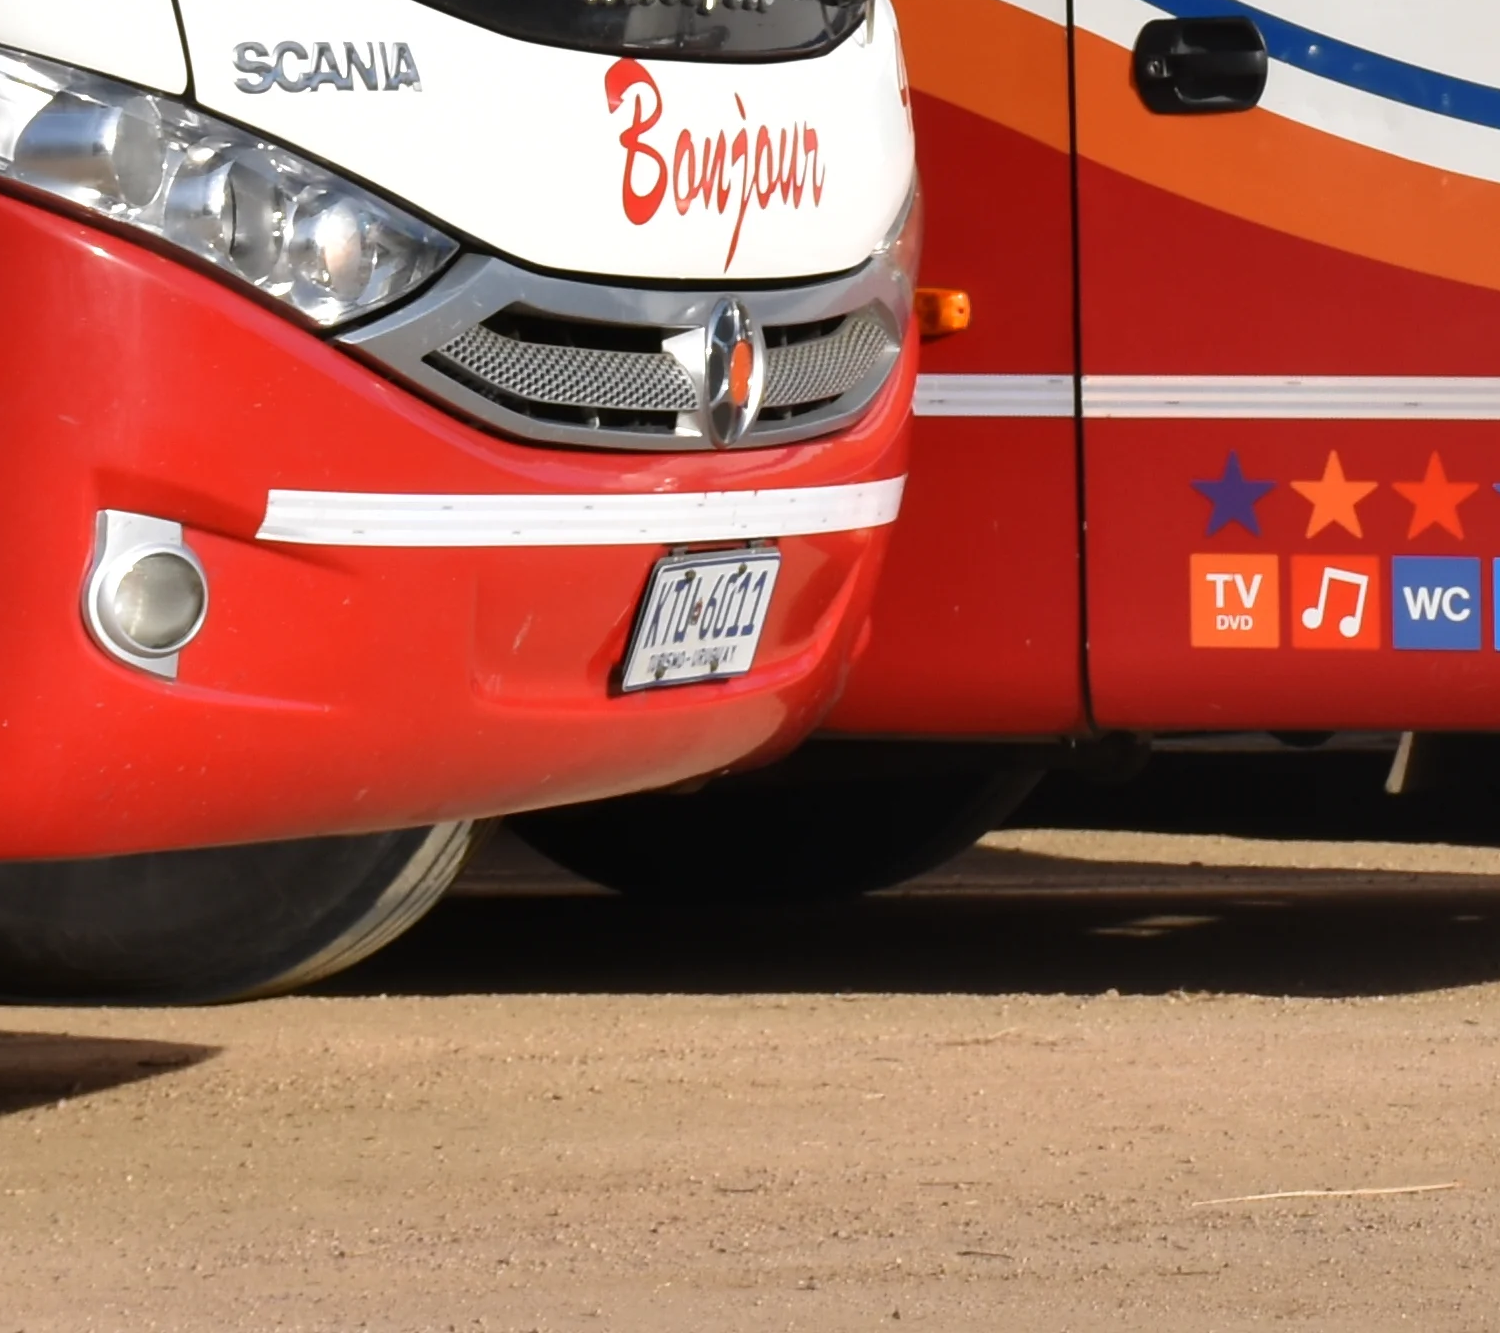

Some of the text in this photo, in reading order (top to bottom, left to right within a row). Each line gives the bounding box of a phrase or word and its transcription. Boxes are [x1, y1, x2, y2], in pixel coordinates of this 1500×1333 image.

[231, 41, 424, 95] SCANIA
[604, 57, 826, 274] Bonjour
[1205, 573, 1264, 610] TV
[1403, 585, 1471, 623] WC
[1215, 614, 1254, 631] DVD
